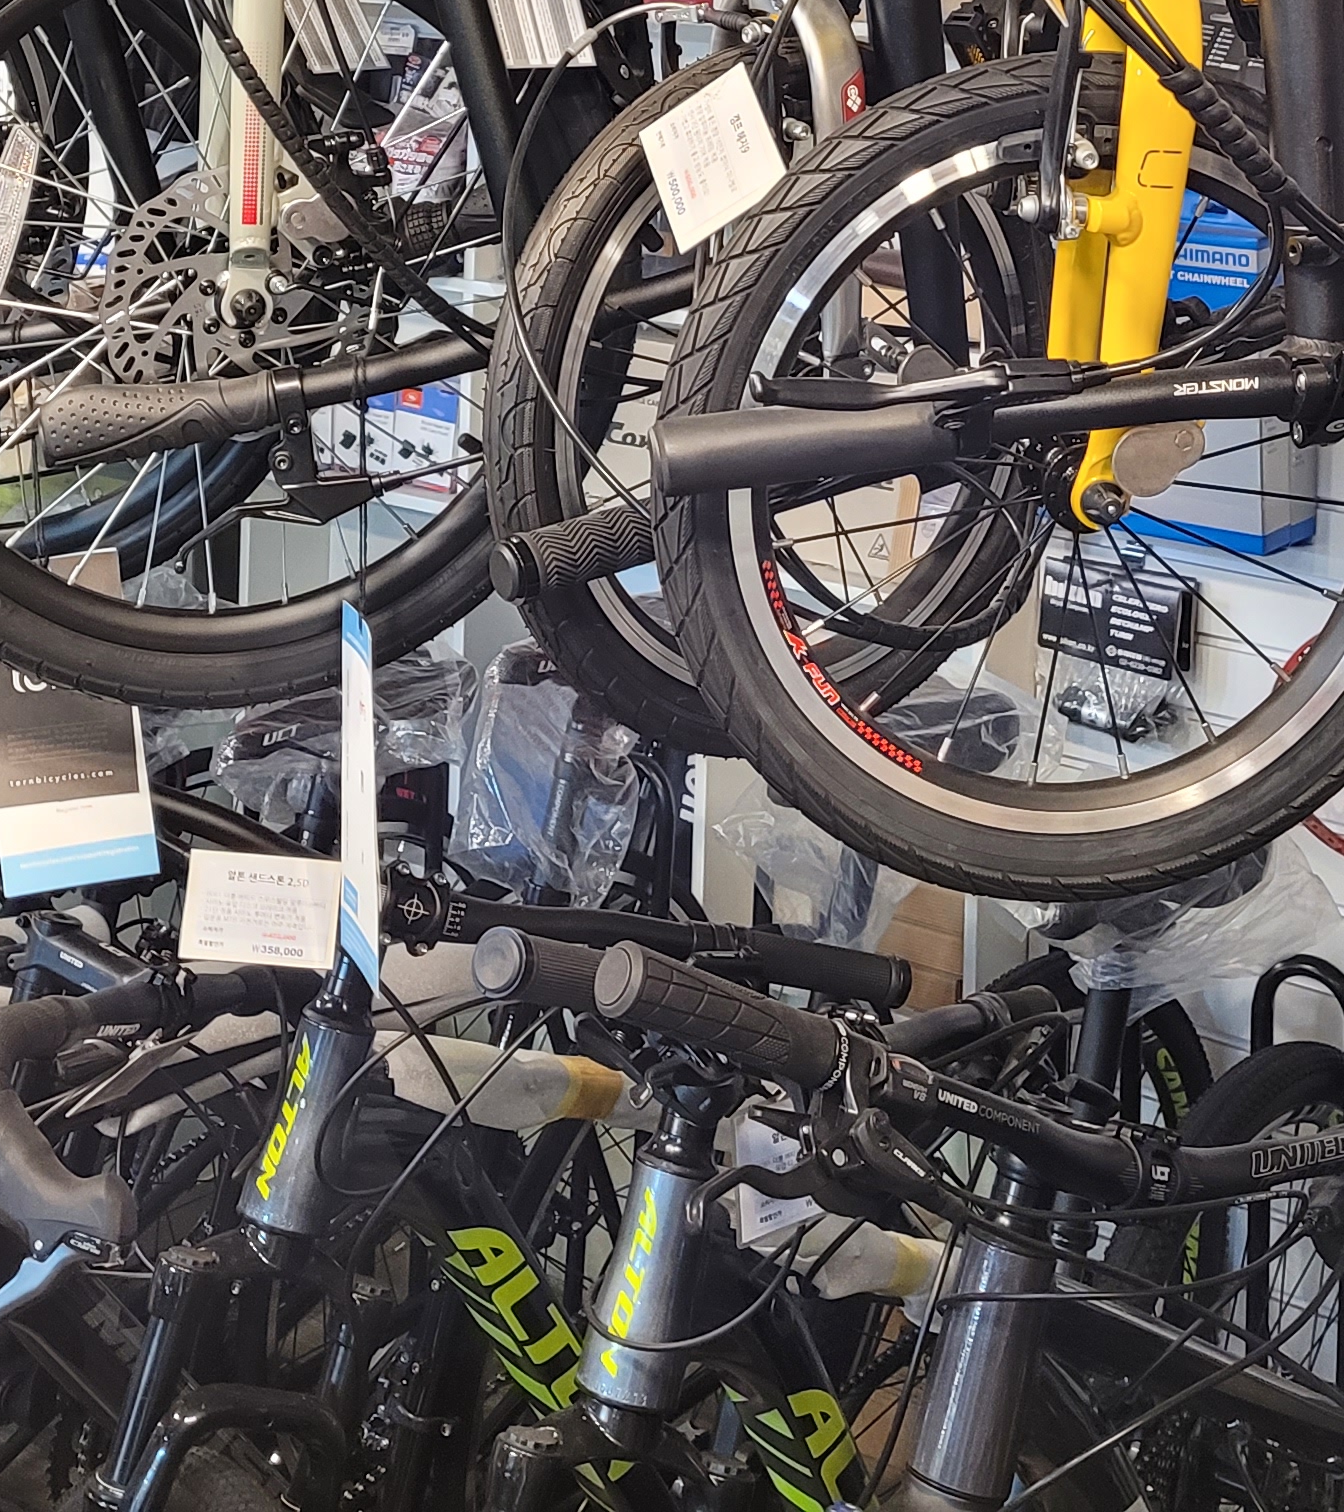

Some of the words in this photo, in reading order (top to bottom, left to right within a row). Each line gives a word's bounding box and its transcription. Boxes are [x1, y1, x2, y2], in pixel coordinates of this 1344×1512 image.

[1176, 248, 1250, 268] HIMANO
[1177, 270, 1250, 288] CHAINWHEEL
[1172, 376, 1259, 397] MONSTER
[262, 723, 302, 747] UCT
[9, 769, 114, 788] ternbicycles.com
[96, 1023, 141, 1036] UNITED
[256, 1033, 311, 1201] ALTON
[937, 1088, 978, 1114] UNITED
[978, 1105, 1042, 1136] COMPONENT
[599, 1186, 659, 1378] ALTON
